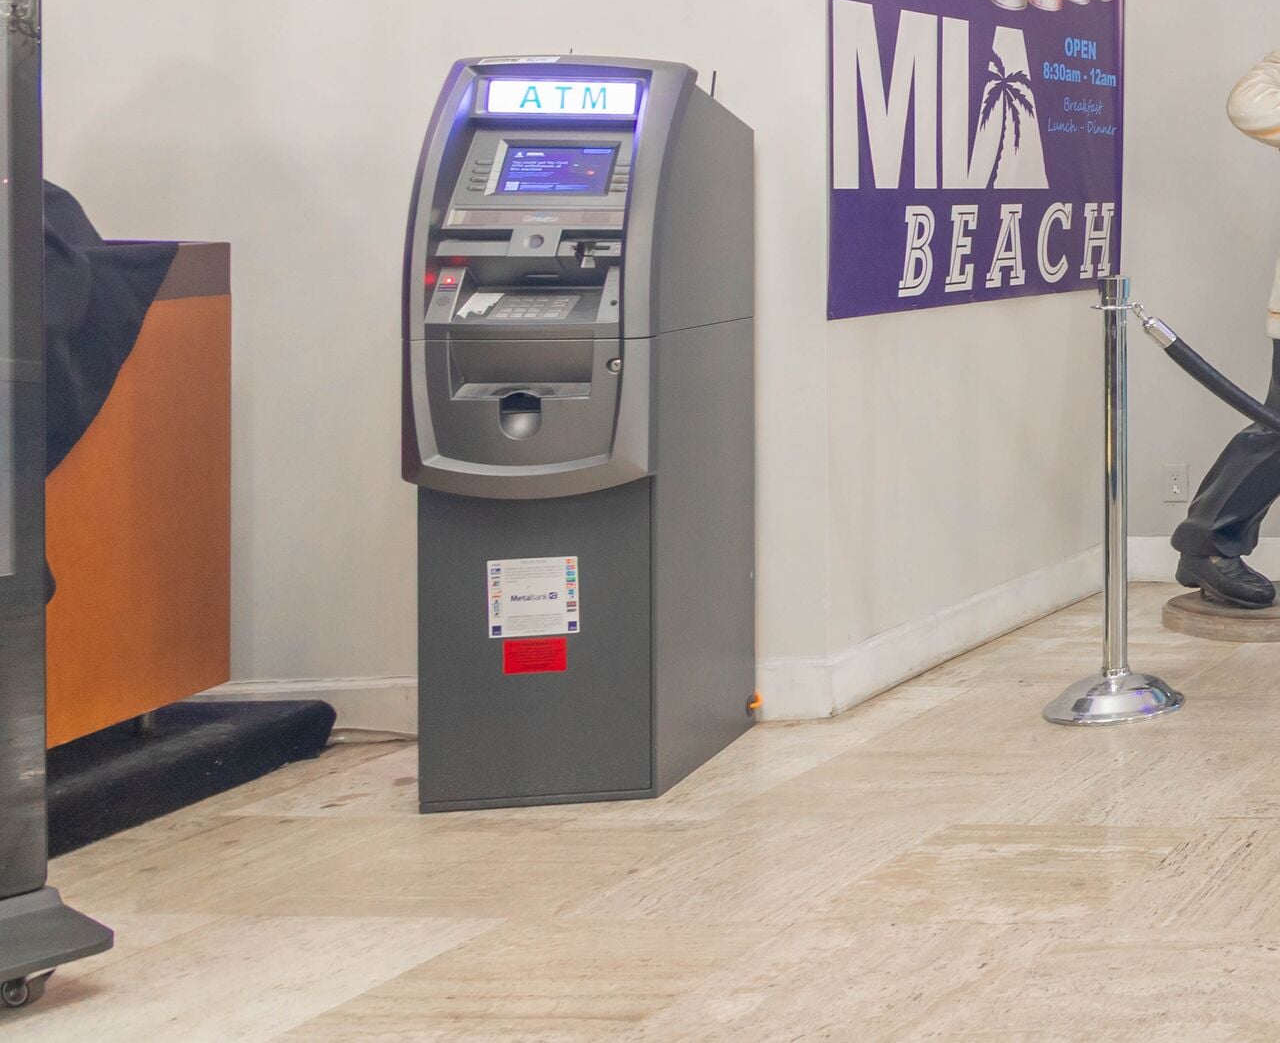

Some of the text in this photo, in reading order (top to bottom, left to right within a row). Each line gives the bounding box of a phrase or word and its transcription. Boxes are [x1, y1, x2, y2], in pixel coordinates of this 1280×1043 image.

[1064, 37, 1097, 60] OPEN
[1043, 62, 1081, 84] 8:30am
[1089, 67, 1117, 87] 12am
[519, 85, 607, 110] ATM
[1063, 97, 1105, 116] Breakfast
[1047, 117, 1078, 133] Lunch
[1087, 120, 1118, 135] Dinner
[897, 202, 1116, 298] BEACH
